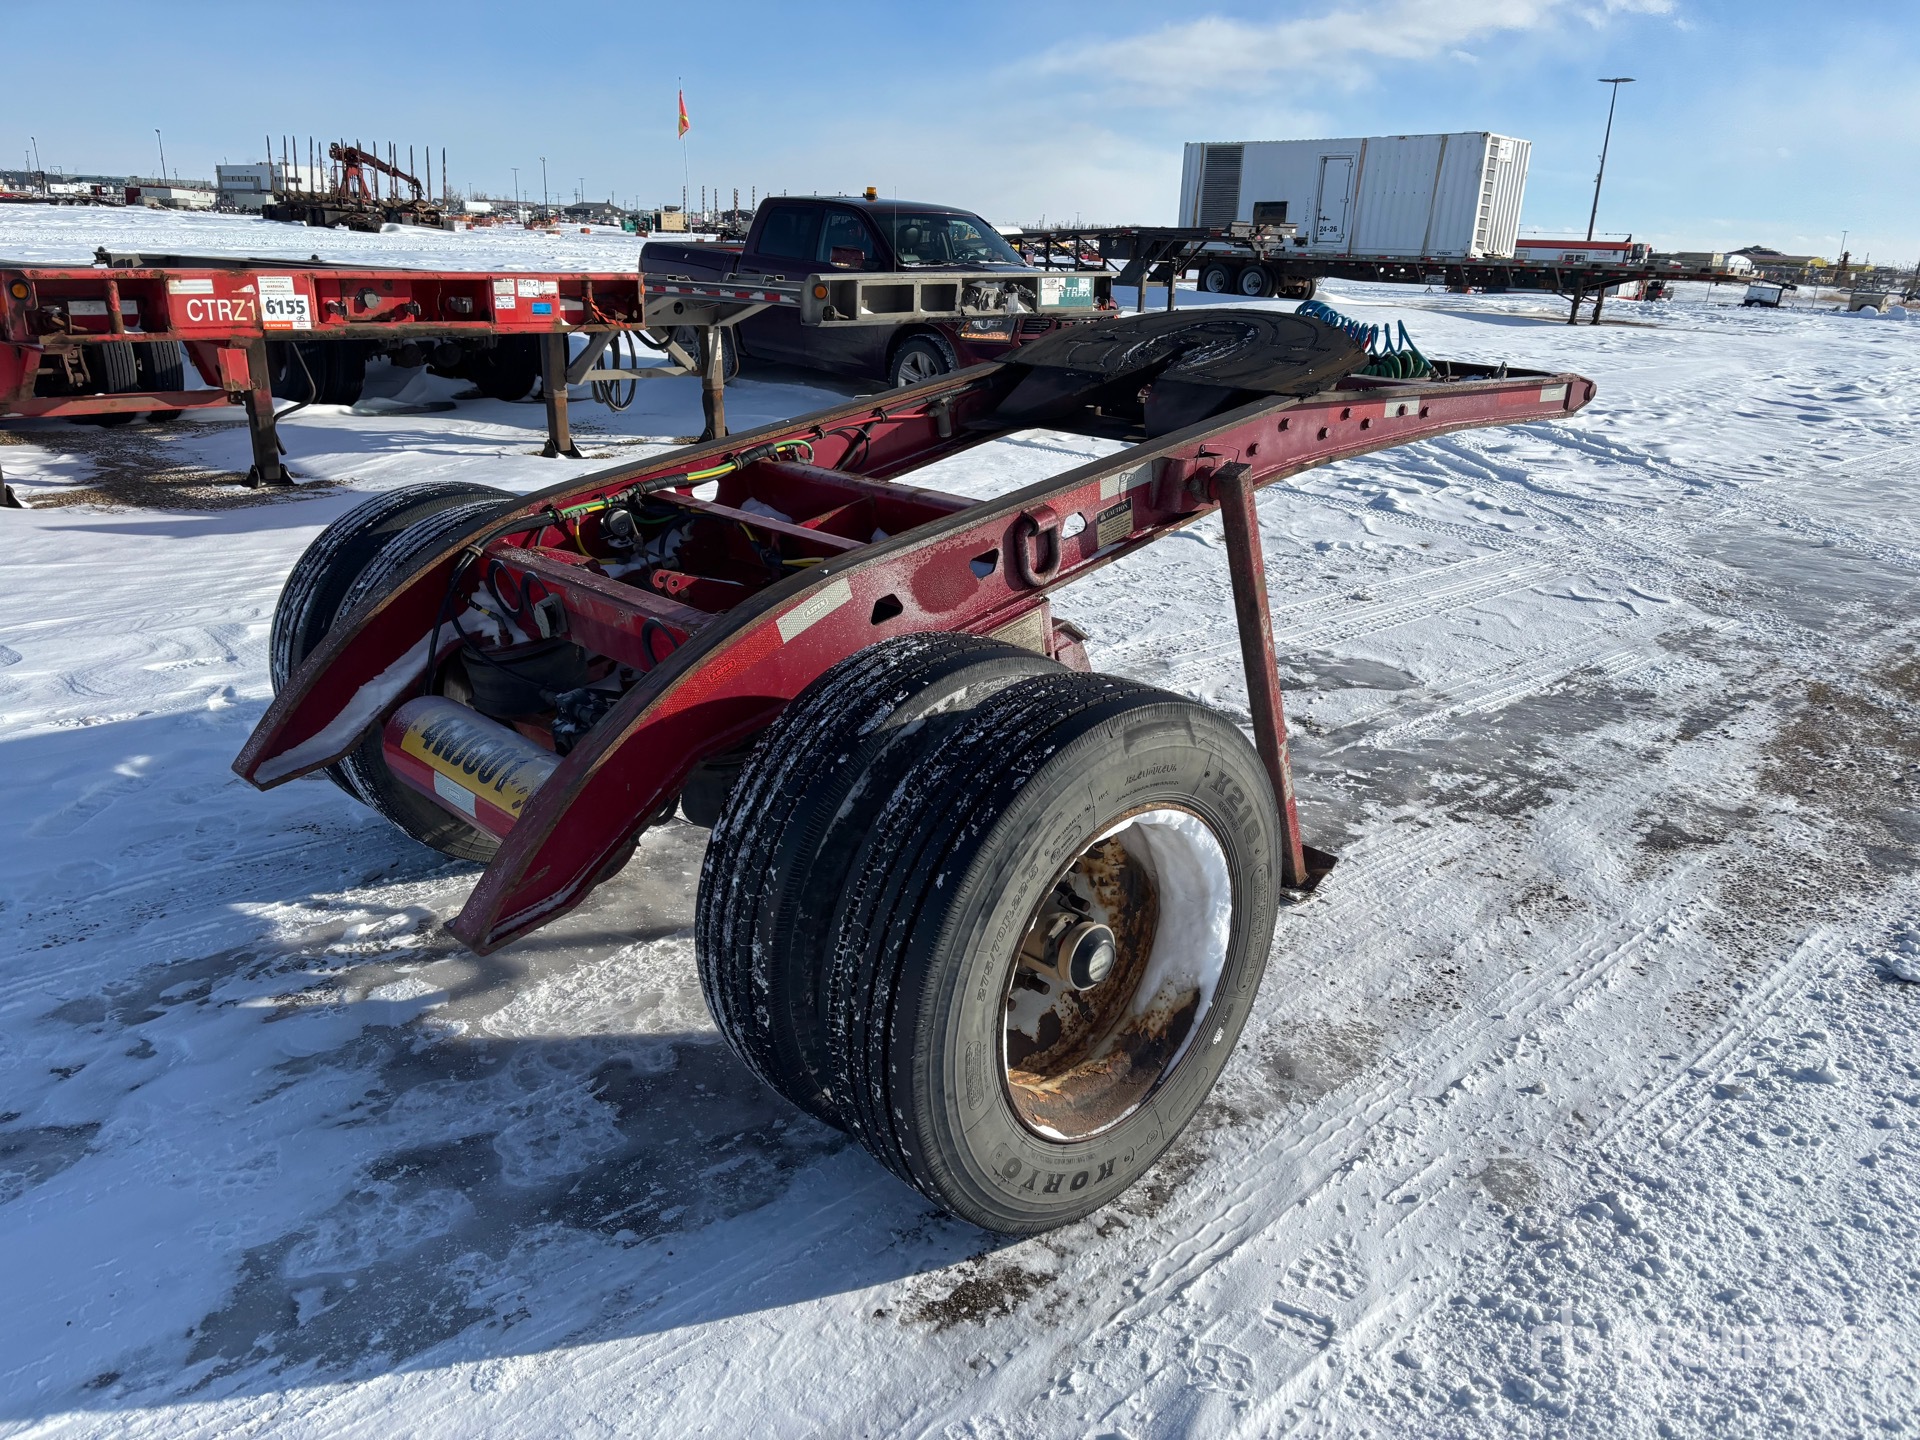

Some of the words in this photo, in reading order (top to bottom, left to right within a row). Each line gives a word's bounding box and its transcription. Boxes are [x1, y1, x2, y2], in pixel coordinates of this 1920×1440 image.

[265, 299, 306, 315] 6155
[1106, 502, 1129, 518] CAUTION
[1002, 1157, 1117, 1193] KORYO
